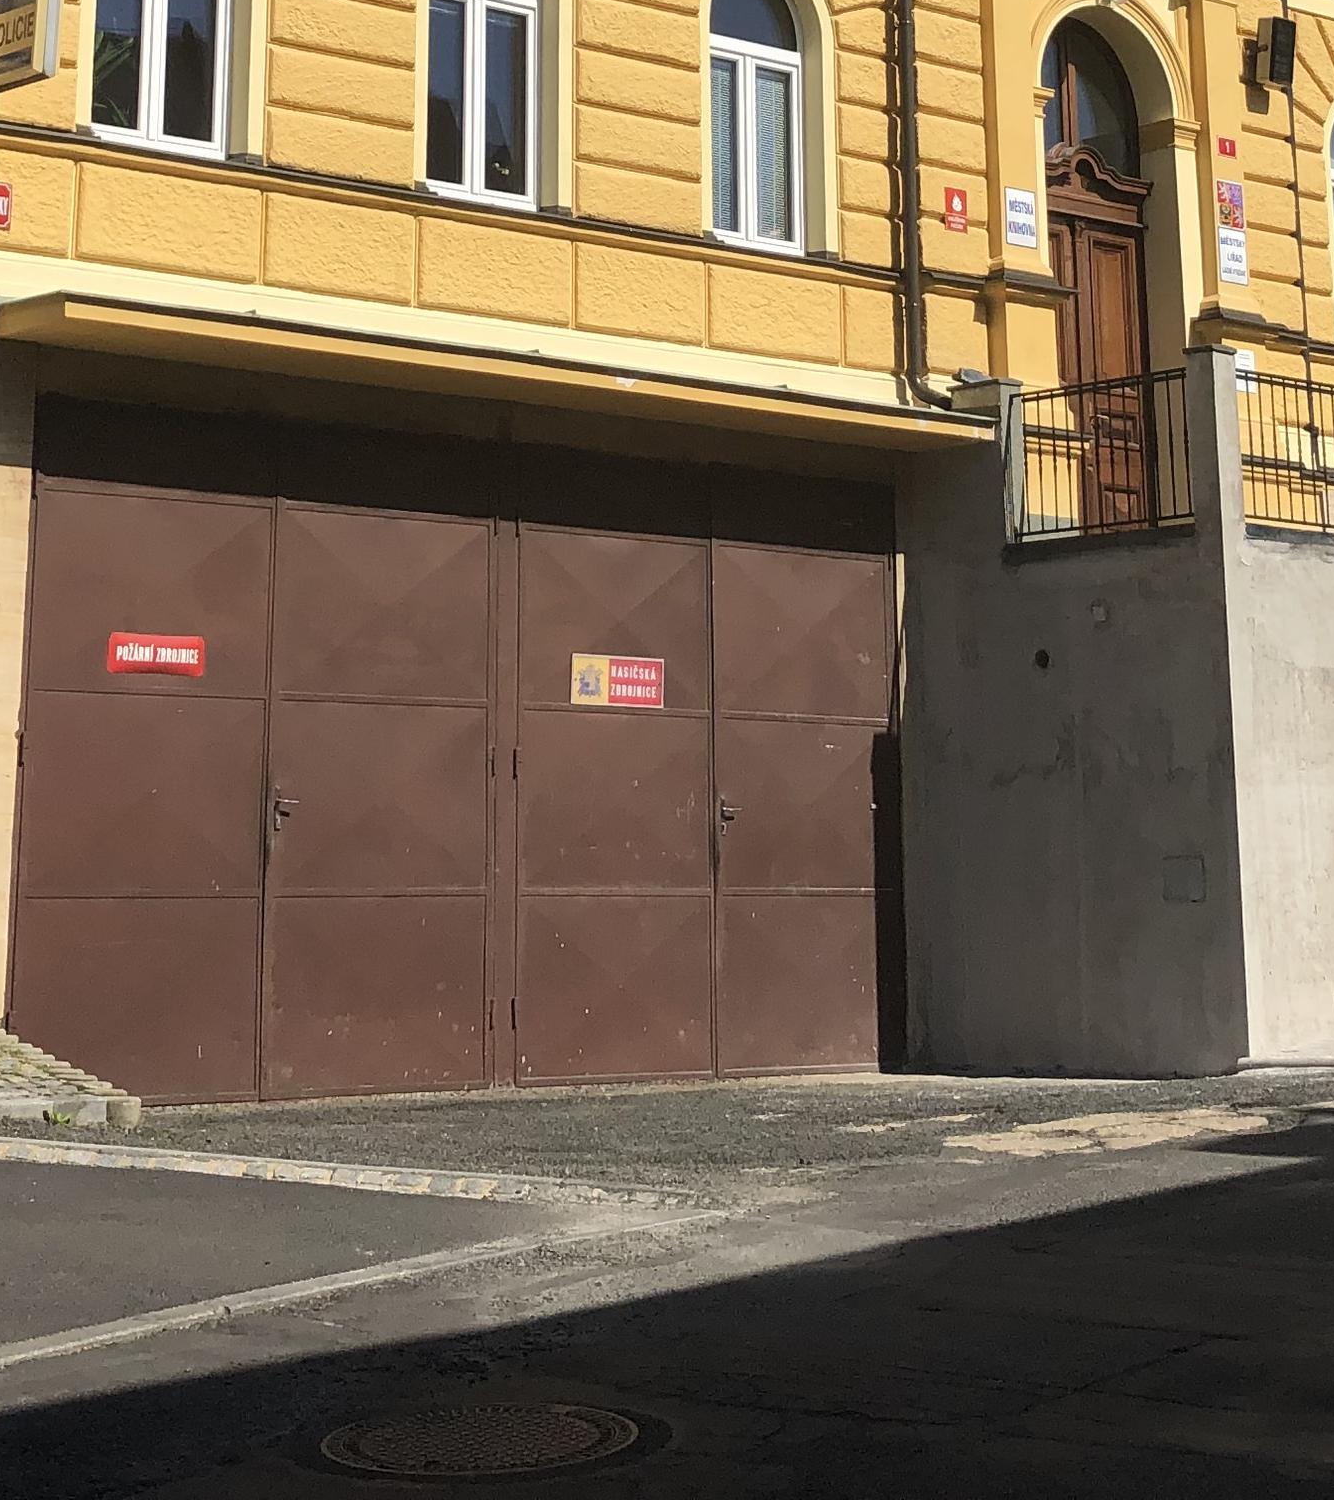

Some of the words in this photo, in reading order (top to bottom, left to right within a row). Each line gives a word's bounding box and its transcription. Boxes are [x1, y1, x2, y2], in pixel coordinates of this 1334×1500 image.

[116, 643, 154, 662] POŽÁRNÍ
[155, 647, 199, 665] ZBROJNICE
[611, 665, 656, 680] HASIČSKÁ
[610, 684, 657, 698] ZBROJNICE
